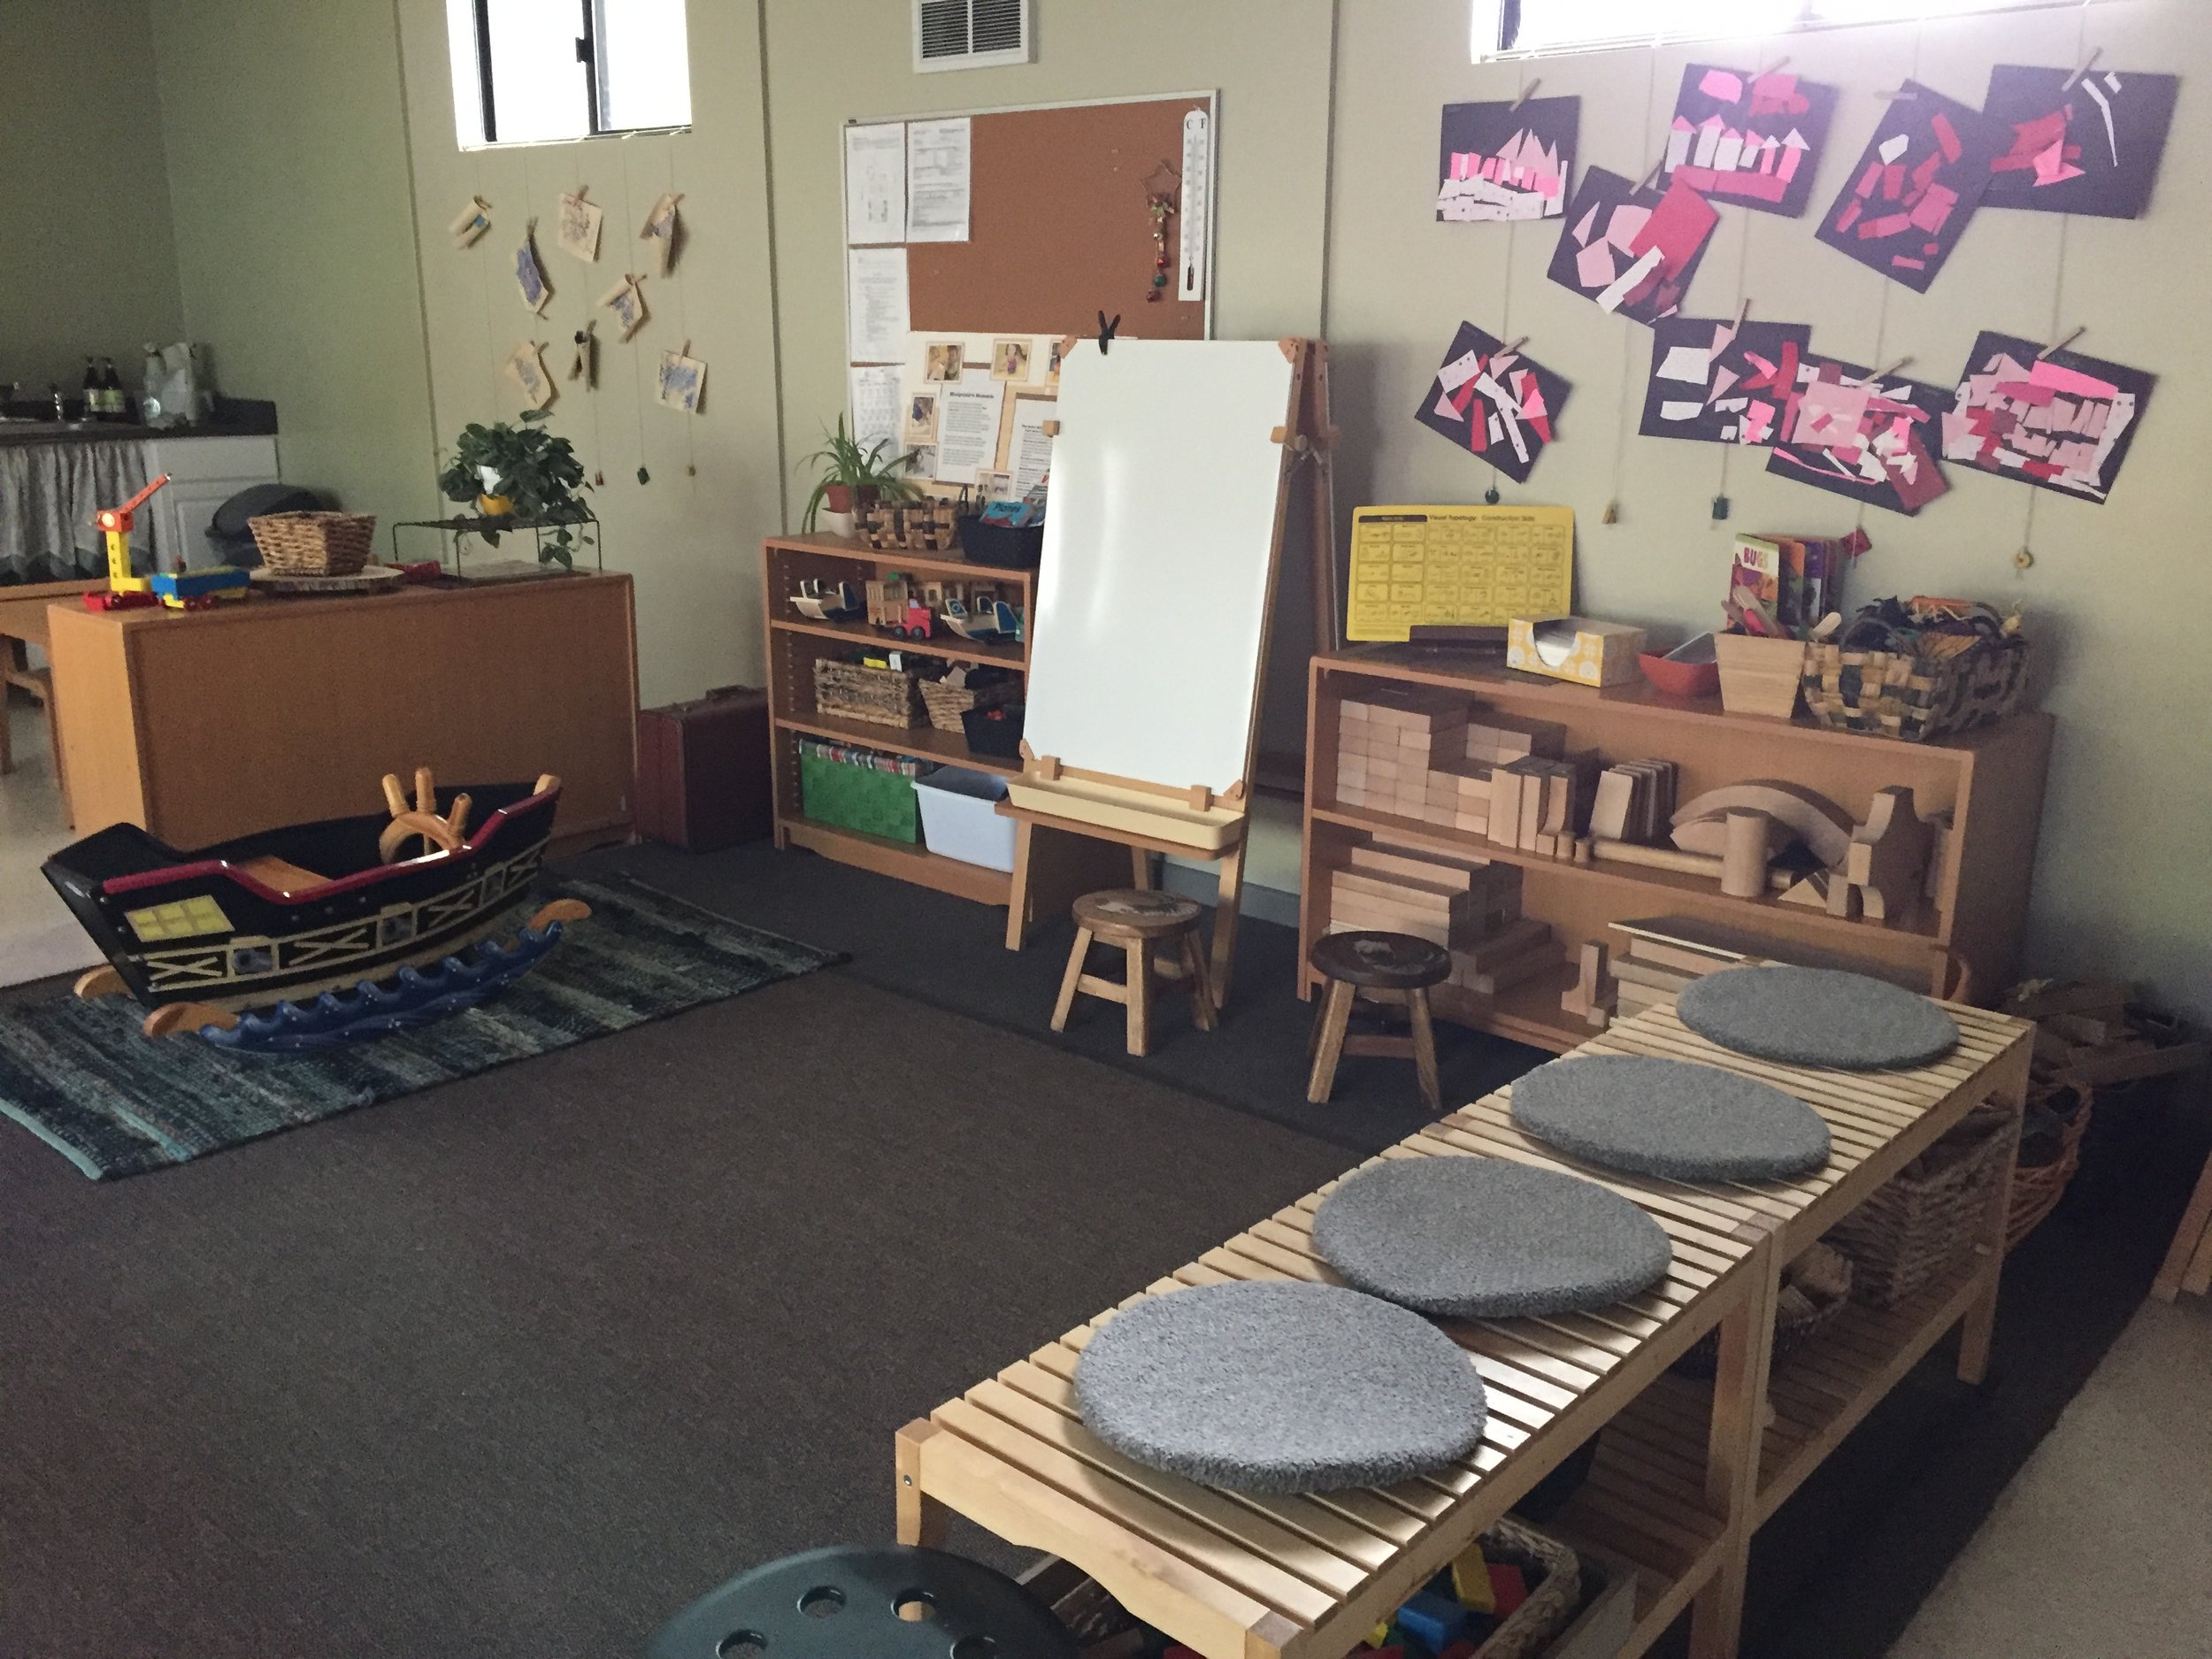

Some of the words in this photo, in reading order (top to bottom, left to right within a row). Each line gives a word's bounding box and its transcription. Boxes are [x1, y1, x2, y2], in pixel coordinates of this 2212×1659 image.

[1187, 119, 1193, 129] C
[1200, 118, 1206, 129] F
[1744, 547, 1768, 568] BUGS
